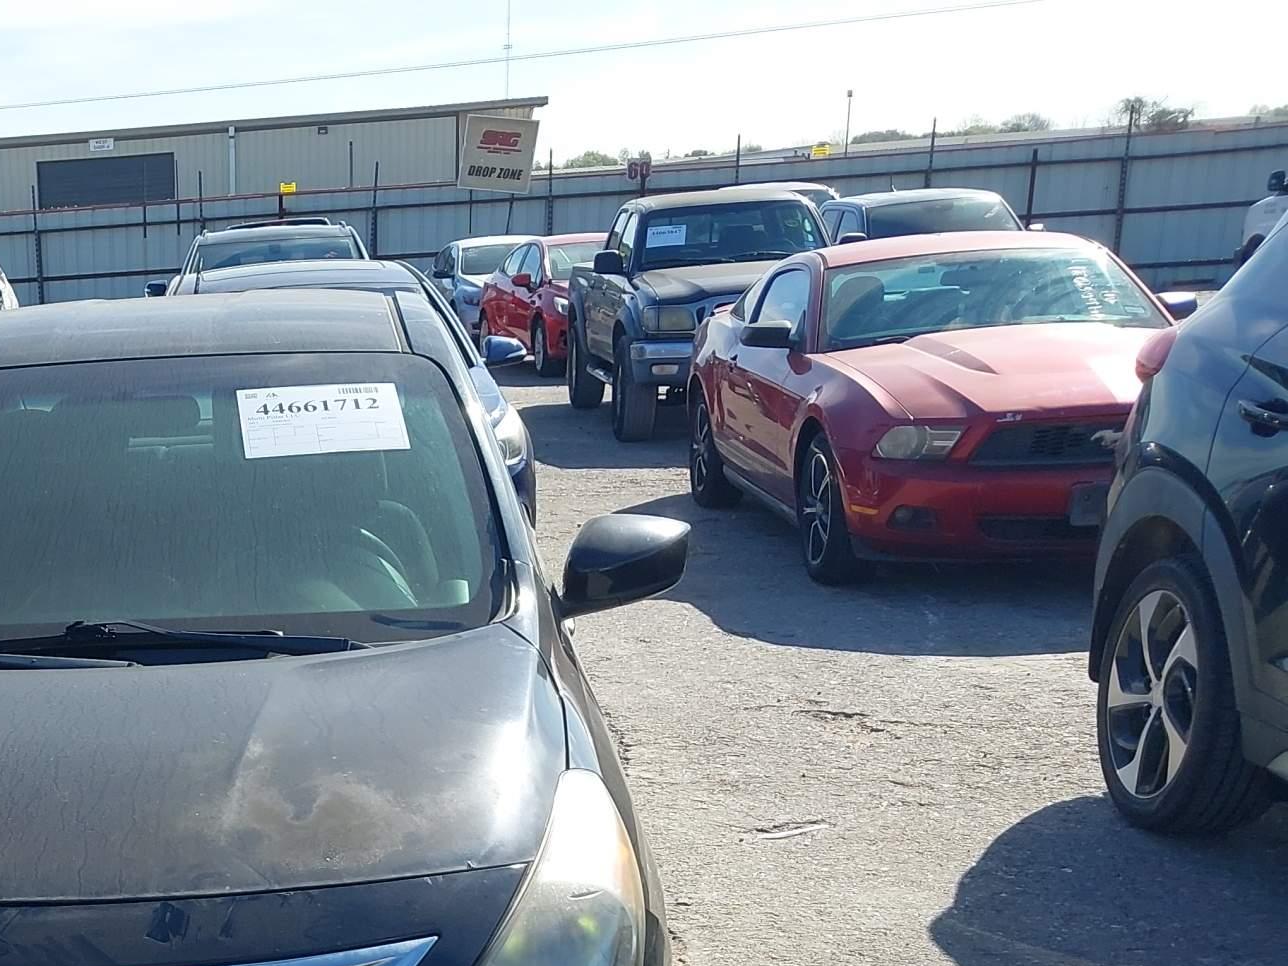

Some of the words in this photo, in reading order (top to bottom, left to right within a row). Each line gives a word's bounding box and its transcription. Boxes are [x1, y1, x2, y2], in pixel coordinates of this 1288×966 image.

[467, 165, 496, 178] DROP
[496, 167, 523, 180] ZONE
[255, 397, 380, 416] 44661712
